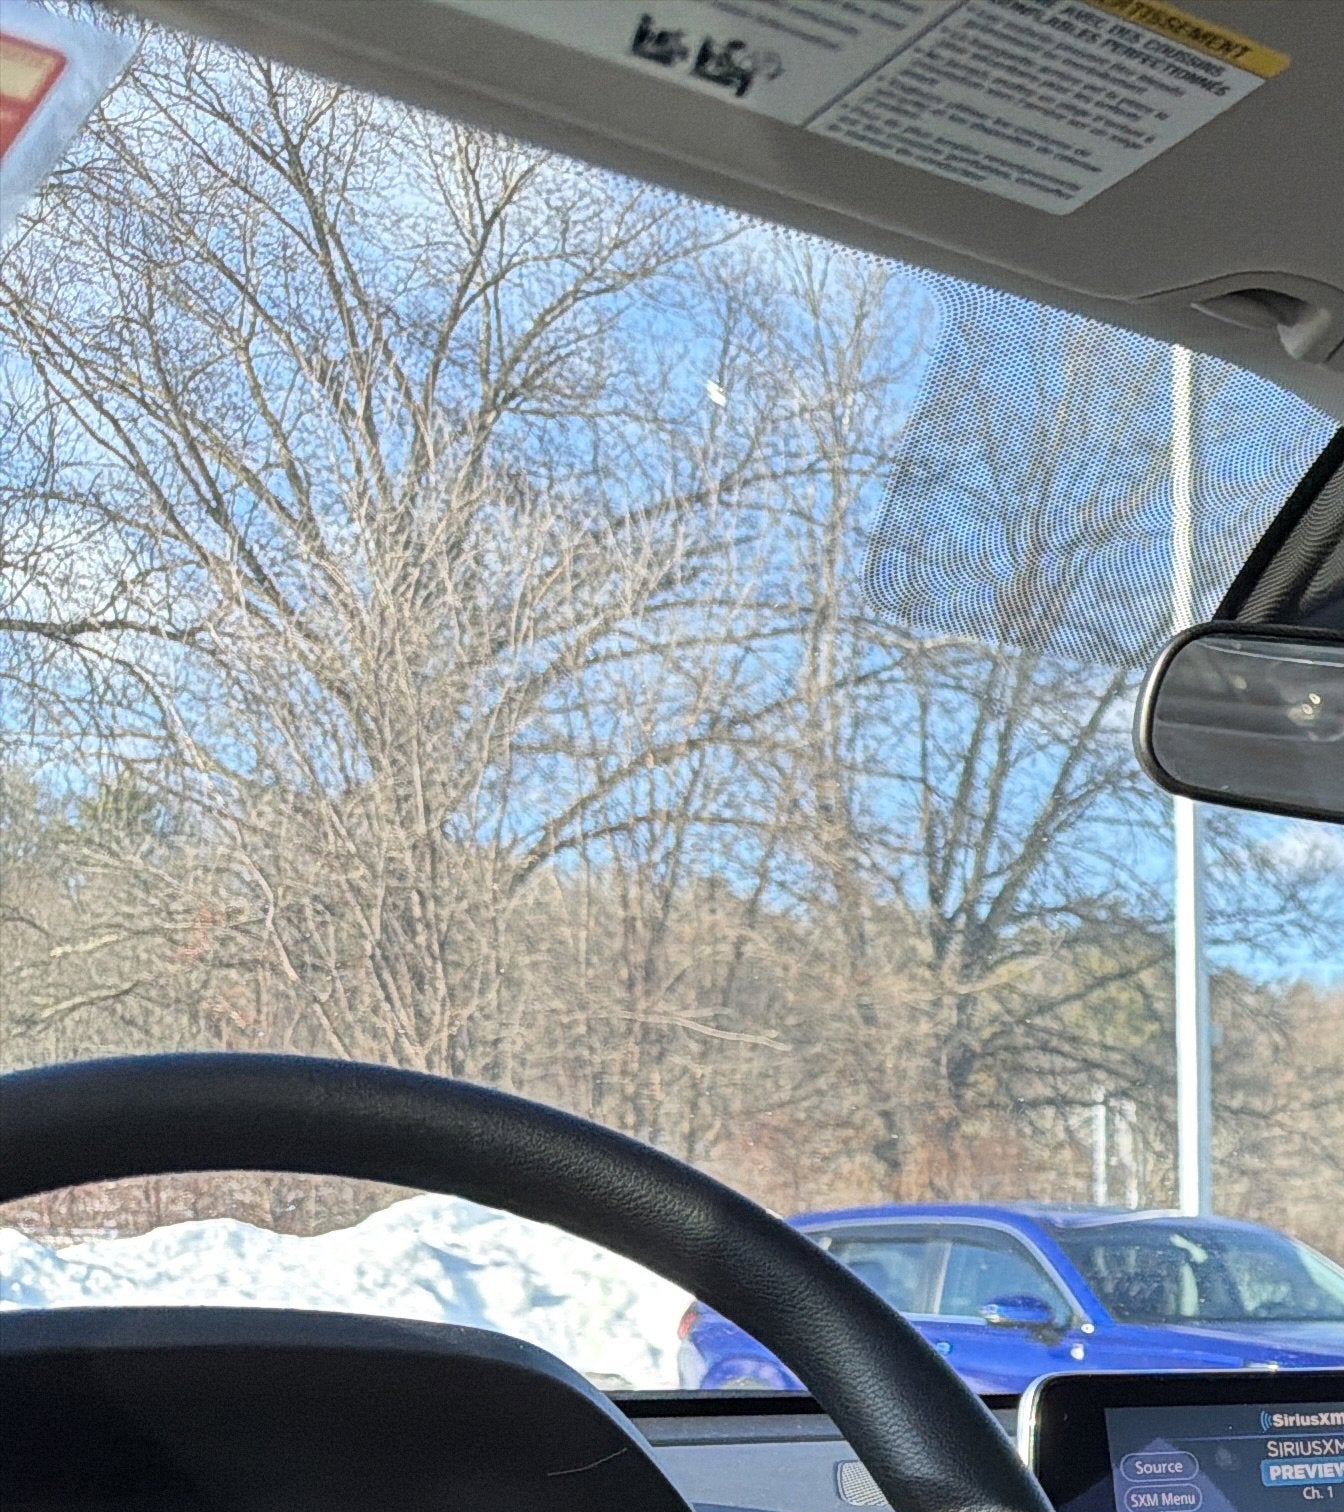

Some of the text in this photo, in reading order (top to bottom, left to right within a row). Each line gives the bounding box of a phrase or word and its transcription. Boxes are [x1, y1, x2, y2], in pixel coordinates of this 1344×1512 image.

[1135, 1460, 1184, 1475] Source
[1130, 1491, 1197, 1509] SXM Menu
[1302, 1486, 1324, 1500] Ch.
